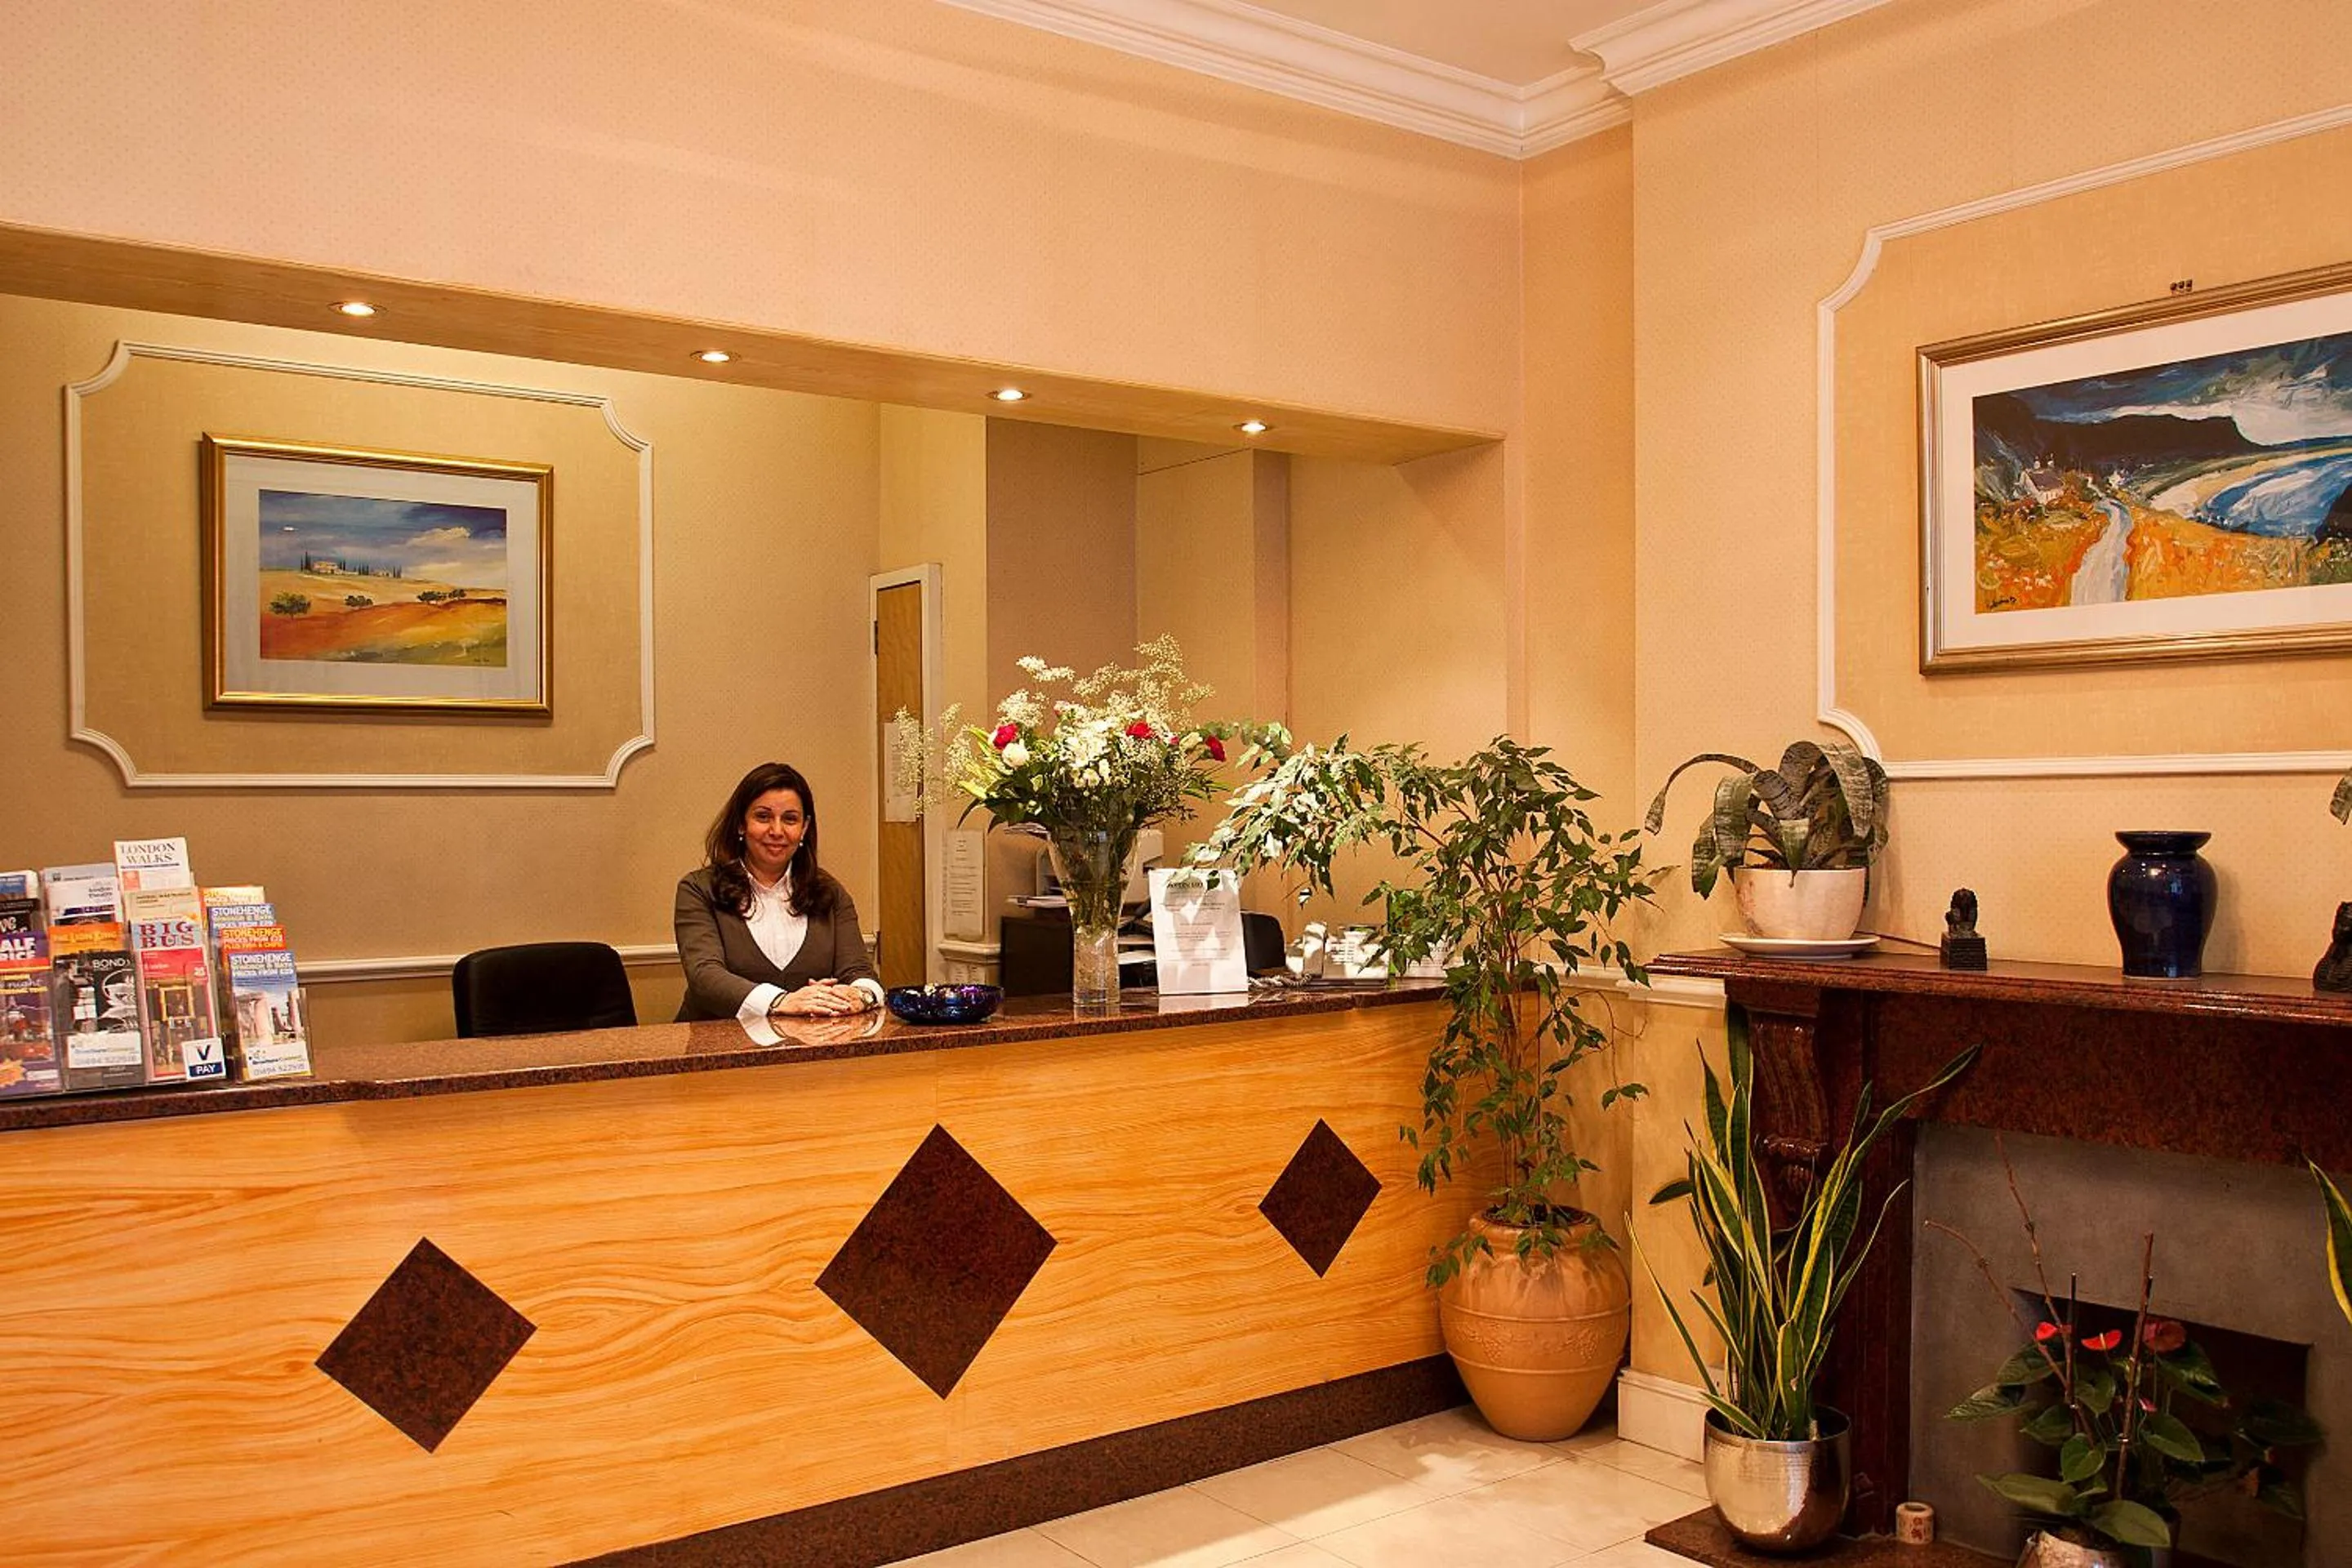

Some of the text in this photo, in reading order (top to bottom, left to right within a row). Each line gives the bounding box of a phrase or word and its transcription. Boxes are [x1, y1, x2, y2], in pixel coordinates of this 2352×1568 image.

[120, 842, 176, 853] LONDON
[126, 853, 173, 863] WALKS
[213, 906, 273, 915] STONEHENGE
[139, 921, 194, 935] BIG
[0, 938, 36, 951] ALF
[139, 933, 194, 947] BUS
[233, 953, 292, 964] STONEHENGE
[196, 1045, 212, 1061] V
[196, 1064, 216, 1075] PAY
